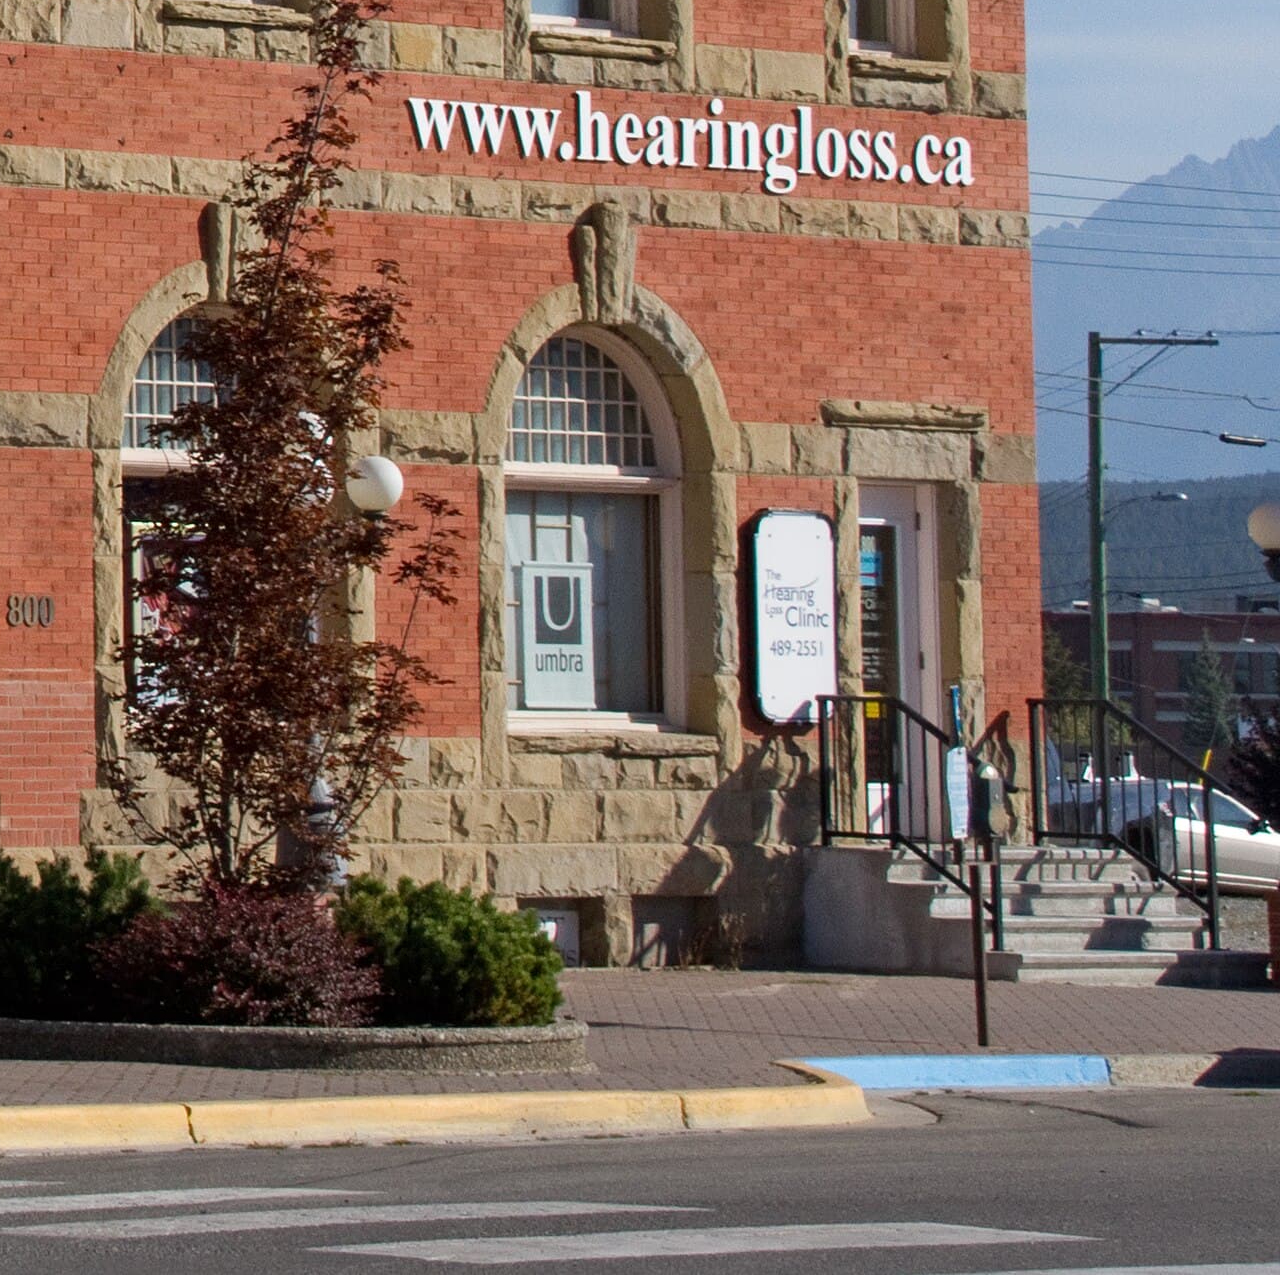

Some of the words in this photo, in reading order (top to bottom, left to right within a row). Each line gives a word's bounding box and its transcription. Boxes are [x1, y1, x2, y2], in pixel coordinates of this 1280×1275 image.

[408, 91, 974, 194] www.hearingloss.ca
[765, 569, 781, 580] The
[763, 584, 815, 607] Hearing
[6, 594, 55, 628] 800
[785, 606, 829, 627] Clinic
[770, 639, 823, 656] 489-2551
[535, 648, 583, 672] umbra
